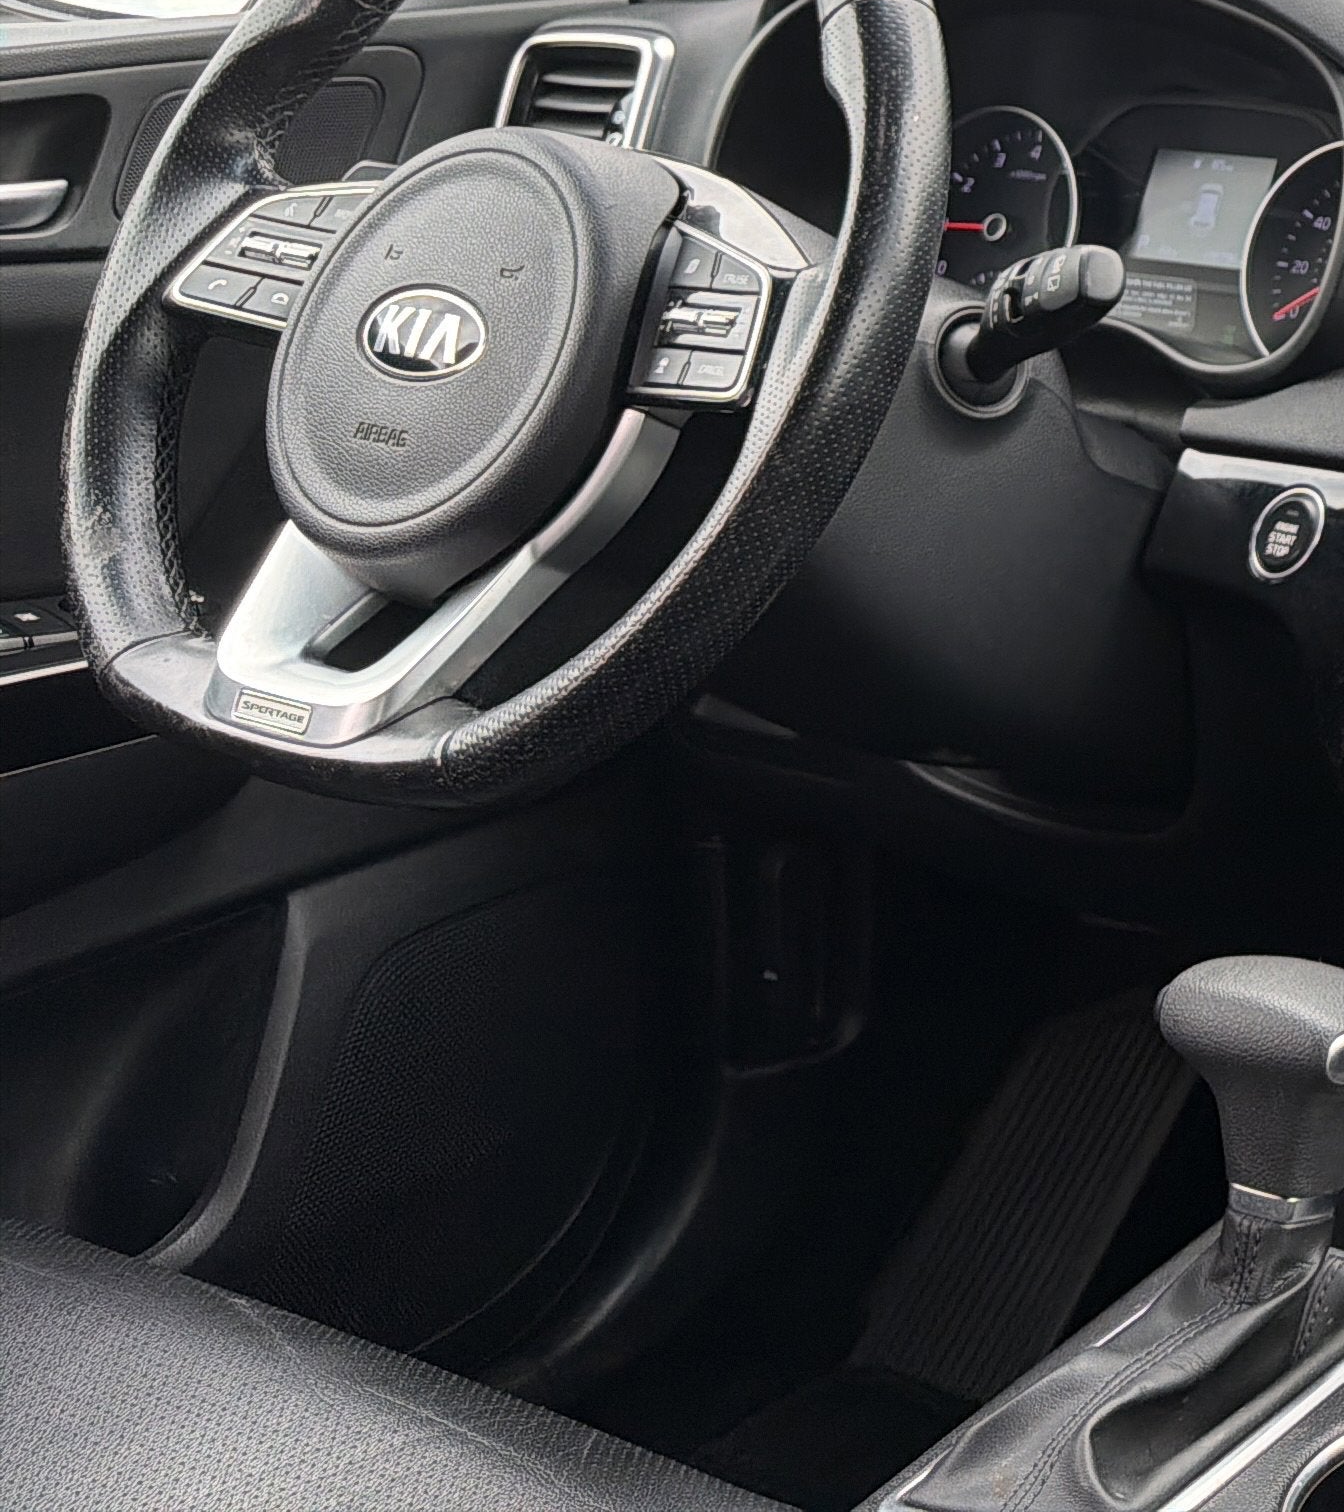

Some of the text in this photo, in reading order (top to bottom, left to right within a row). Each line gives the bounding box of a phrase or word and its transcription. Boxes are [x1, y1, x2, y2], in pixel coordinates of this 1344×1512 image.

[961, 177, 975, 193] 2
[1313, 216, 1332, 231] 40
[1291, 259, 1310, 275] 20
[373, 304, 461, 364] KIA
[353, 420, 409, 449] AIRBAG
[1267, 530, 1298, 547] START
[1264, 542, 1291, 557] STOP
[241, 700, 305, 724] SPORTAGE
